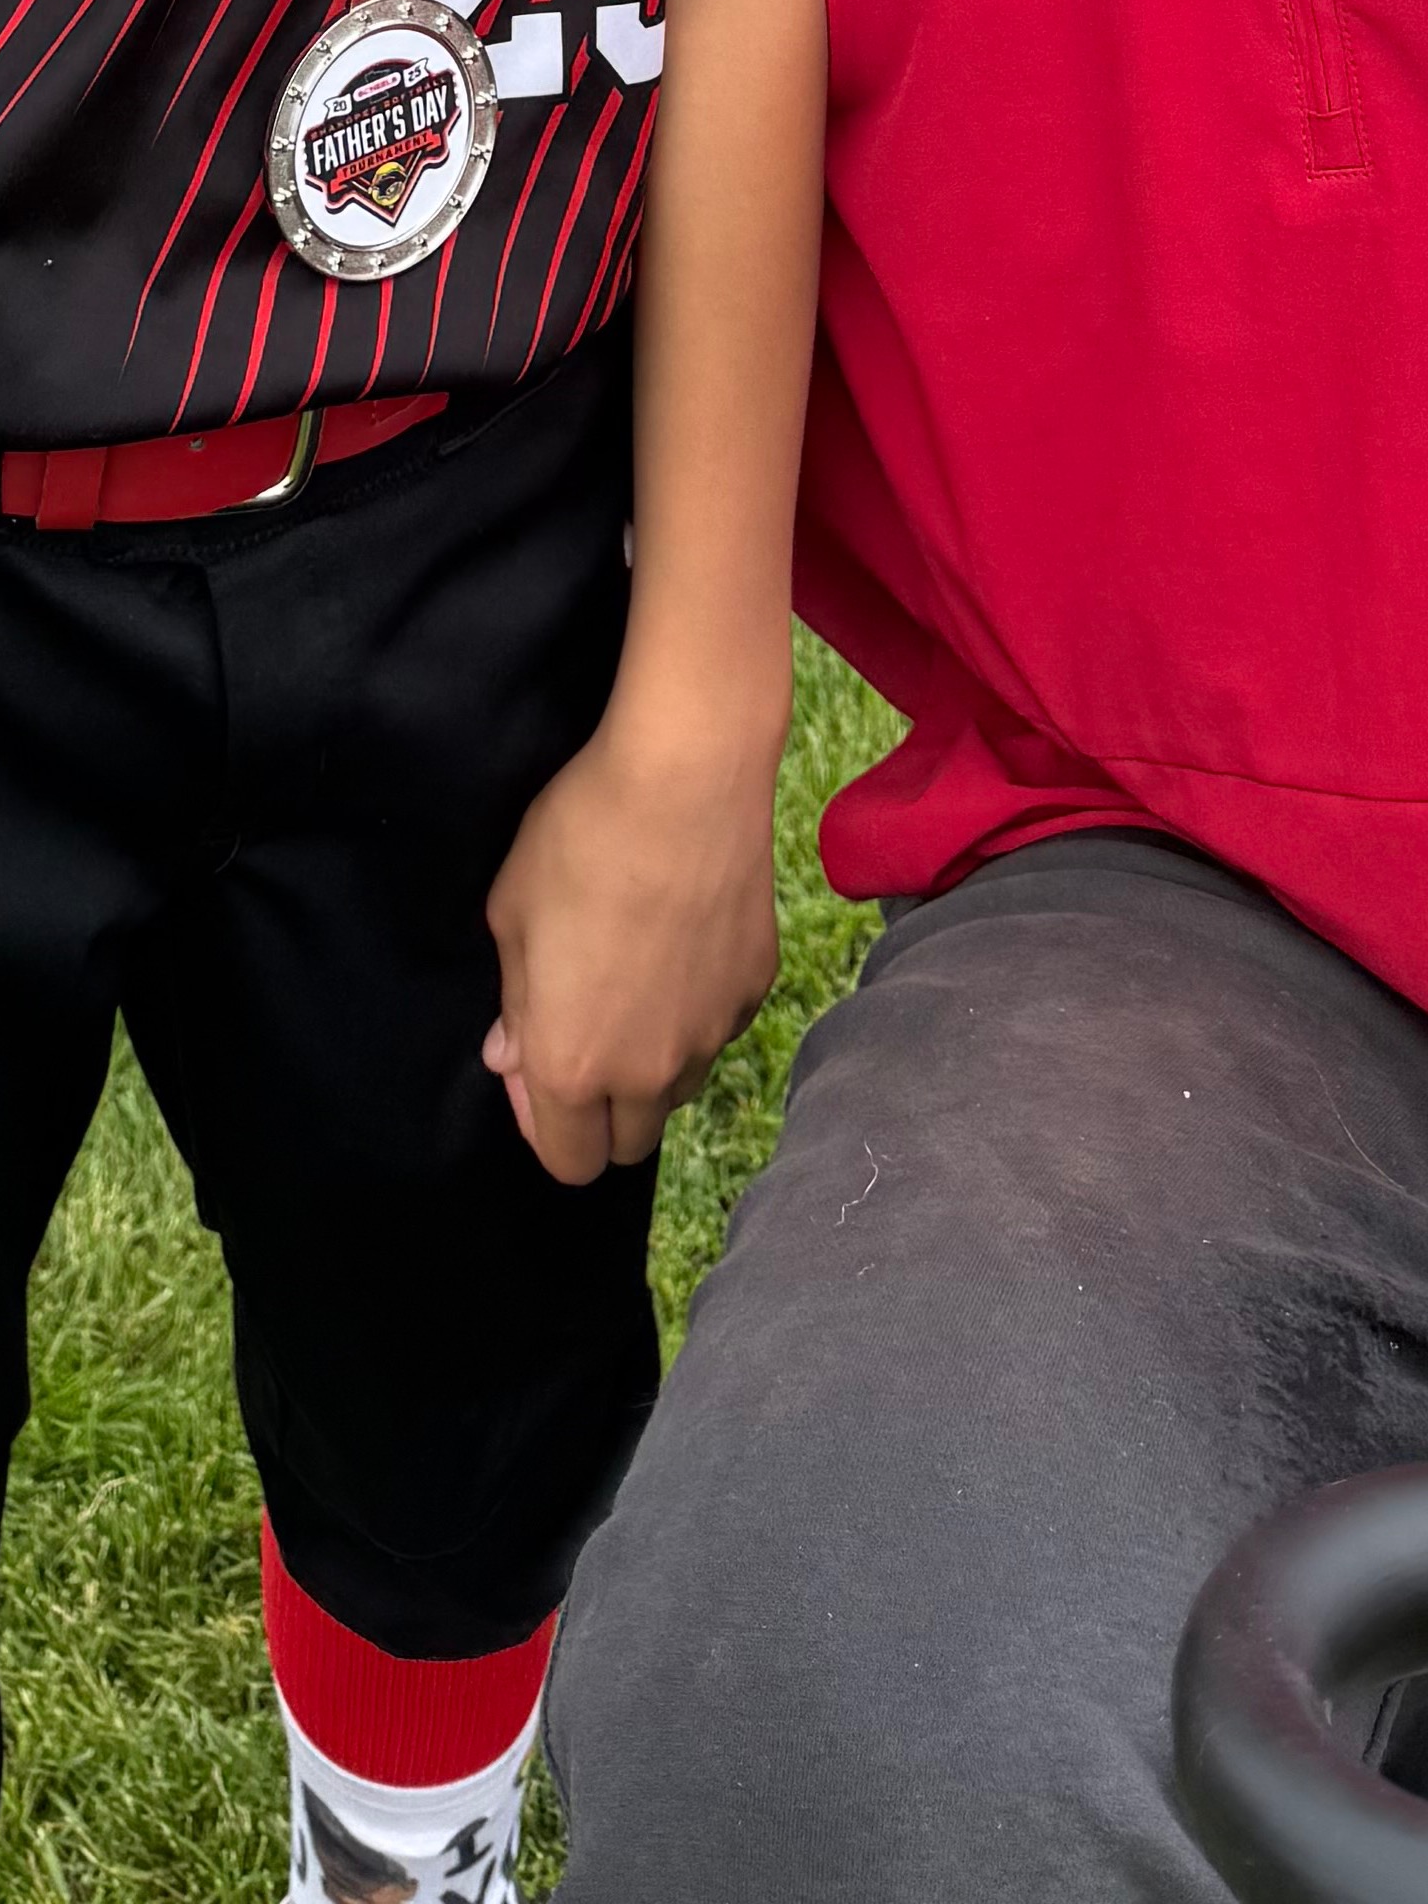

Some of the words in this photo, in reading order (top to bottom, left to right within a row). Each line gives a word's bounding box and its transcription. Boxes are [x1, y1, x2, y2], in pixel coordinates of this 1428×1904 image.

[332, 99, 348, 112] 20
[312, 104, 406, 176] FATHER'S
[410, 84, 448, 132] DAY
[342, 134, 428, 178] TOURNAMENT
